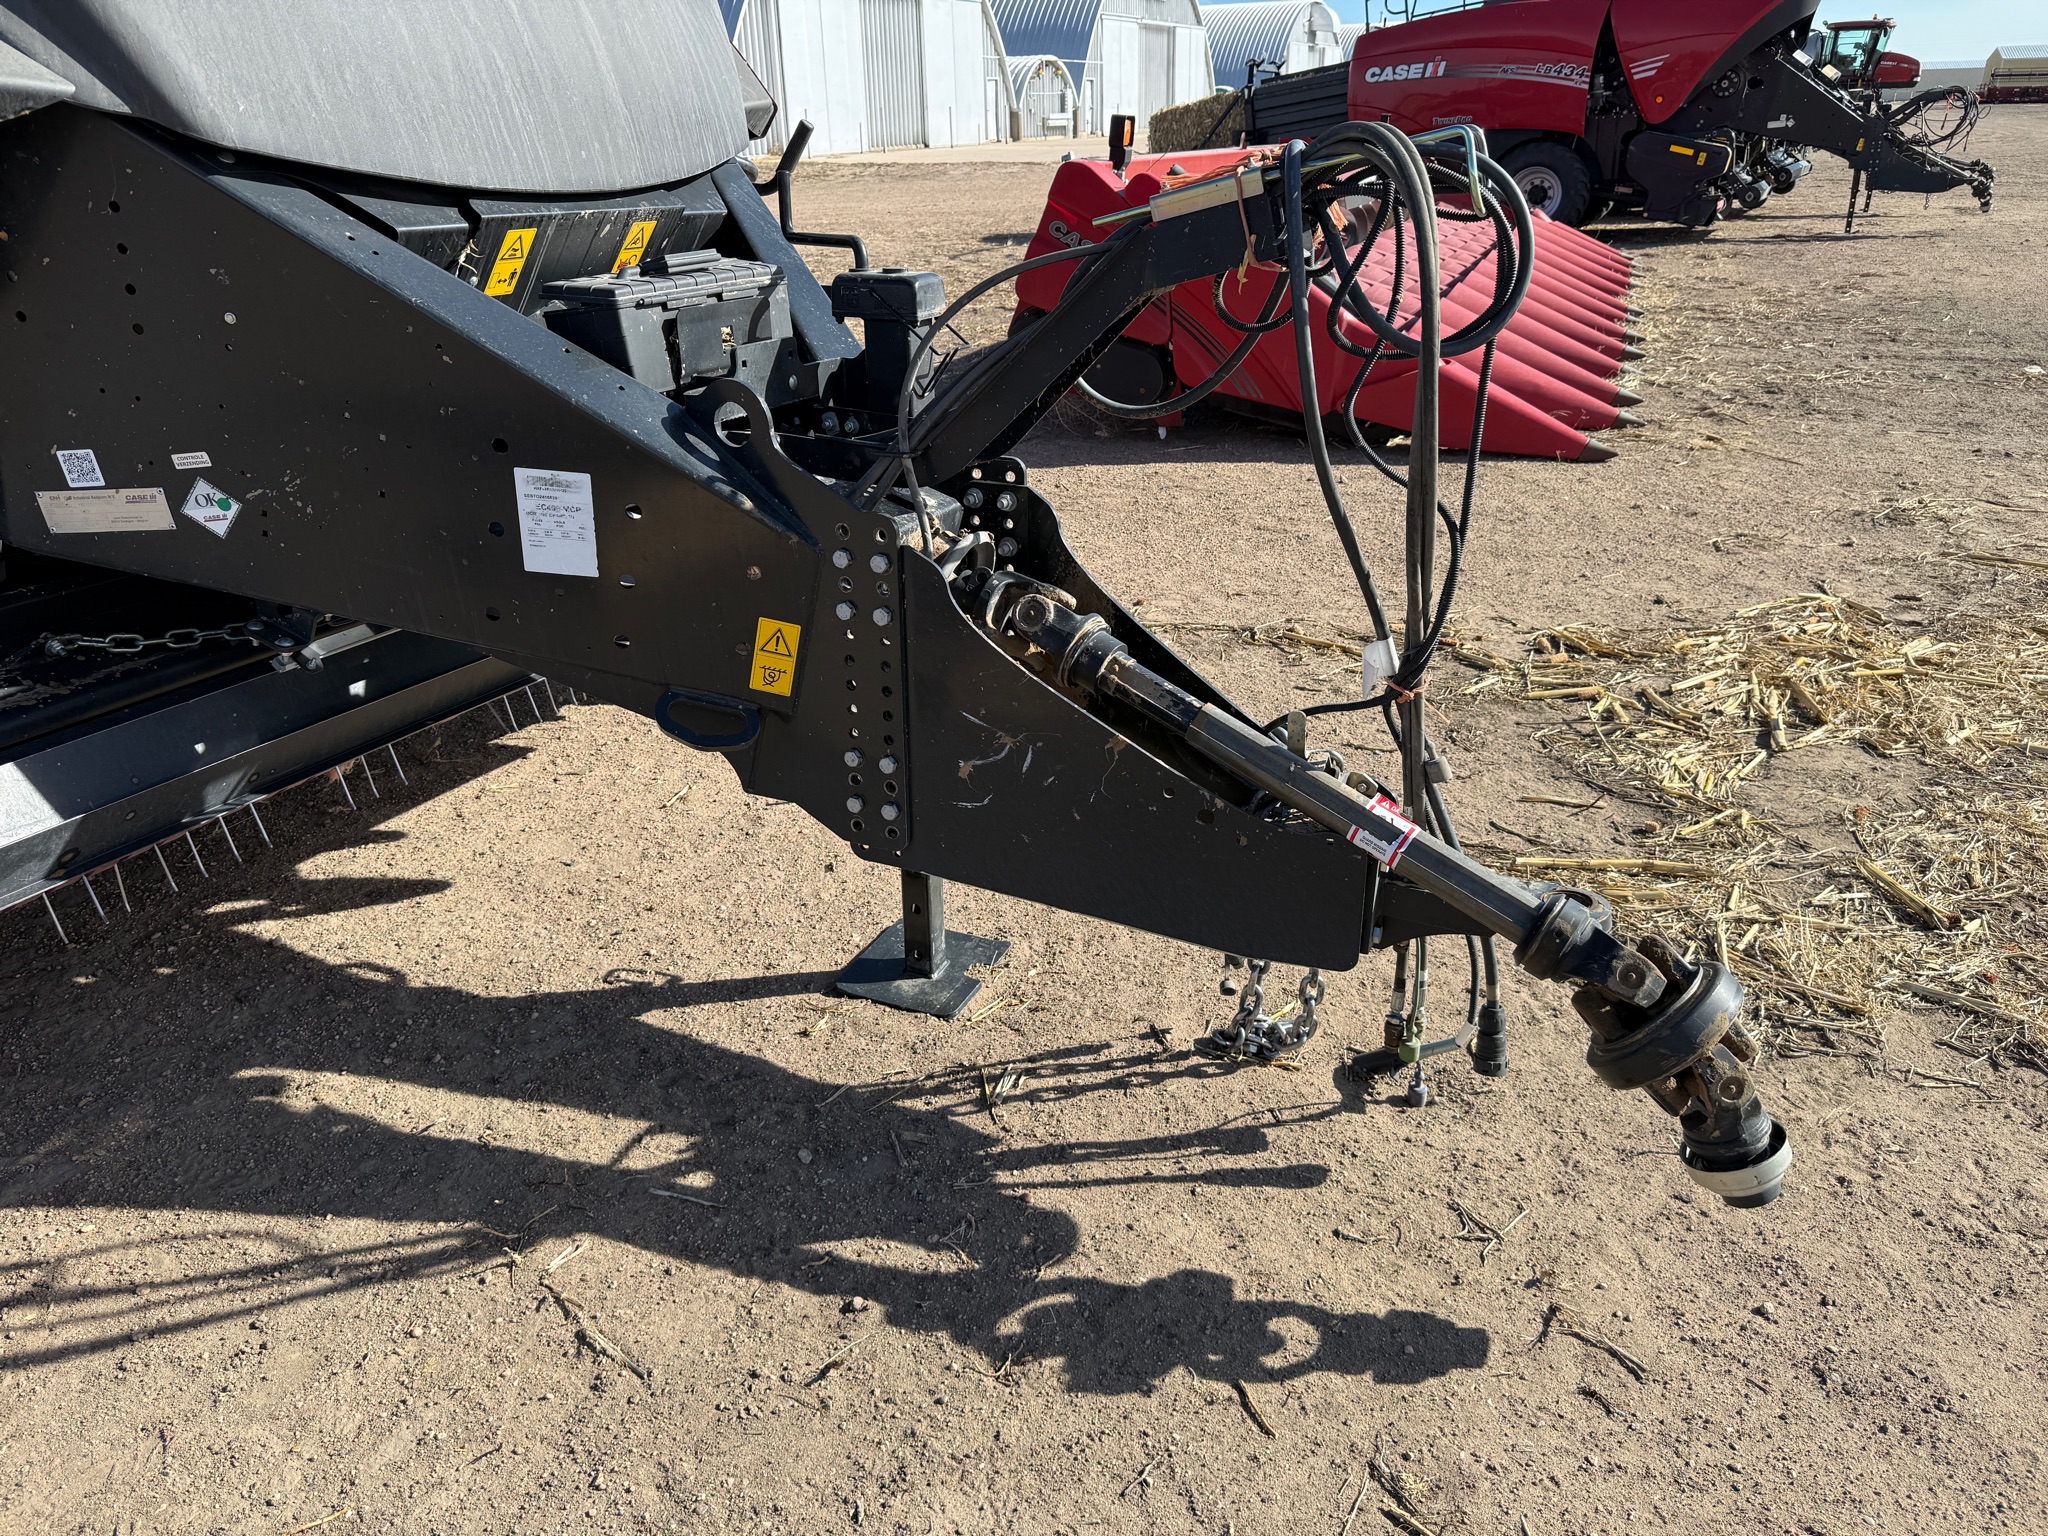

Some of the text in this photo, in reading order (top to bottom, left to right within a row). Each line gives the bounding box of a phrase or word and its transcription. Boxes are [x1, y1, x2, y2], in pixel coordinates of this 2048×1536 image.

[1364, 63, 1424, 84] CASE
[1535, 63, 1588, 79] LB434
[175, 460, 210, 468] VERZENDING
[194, 492, 218, 508] OK
